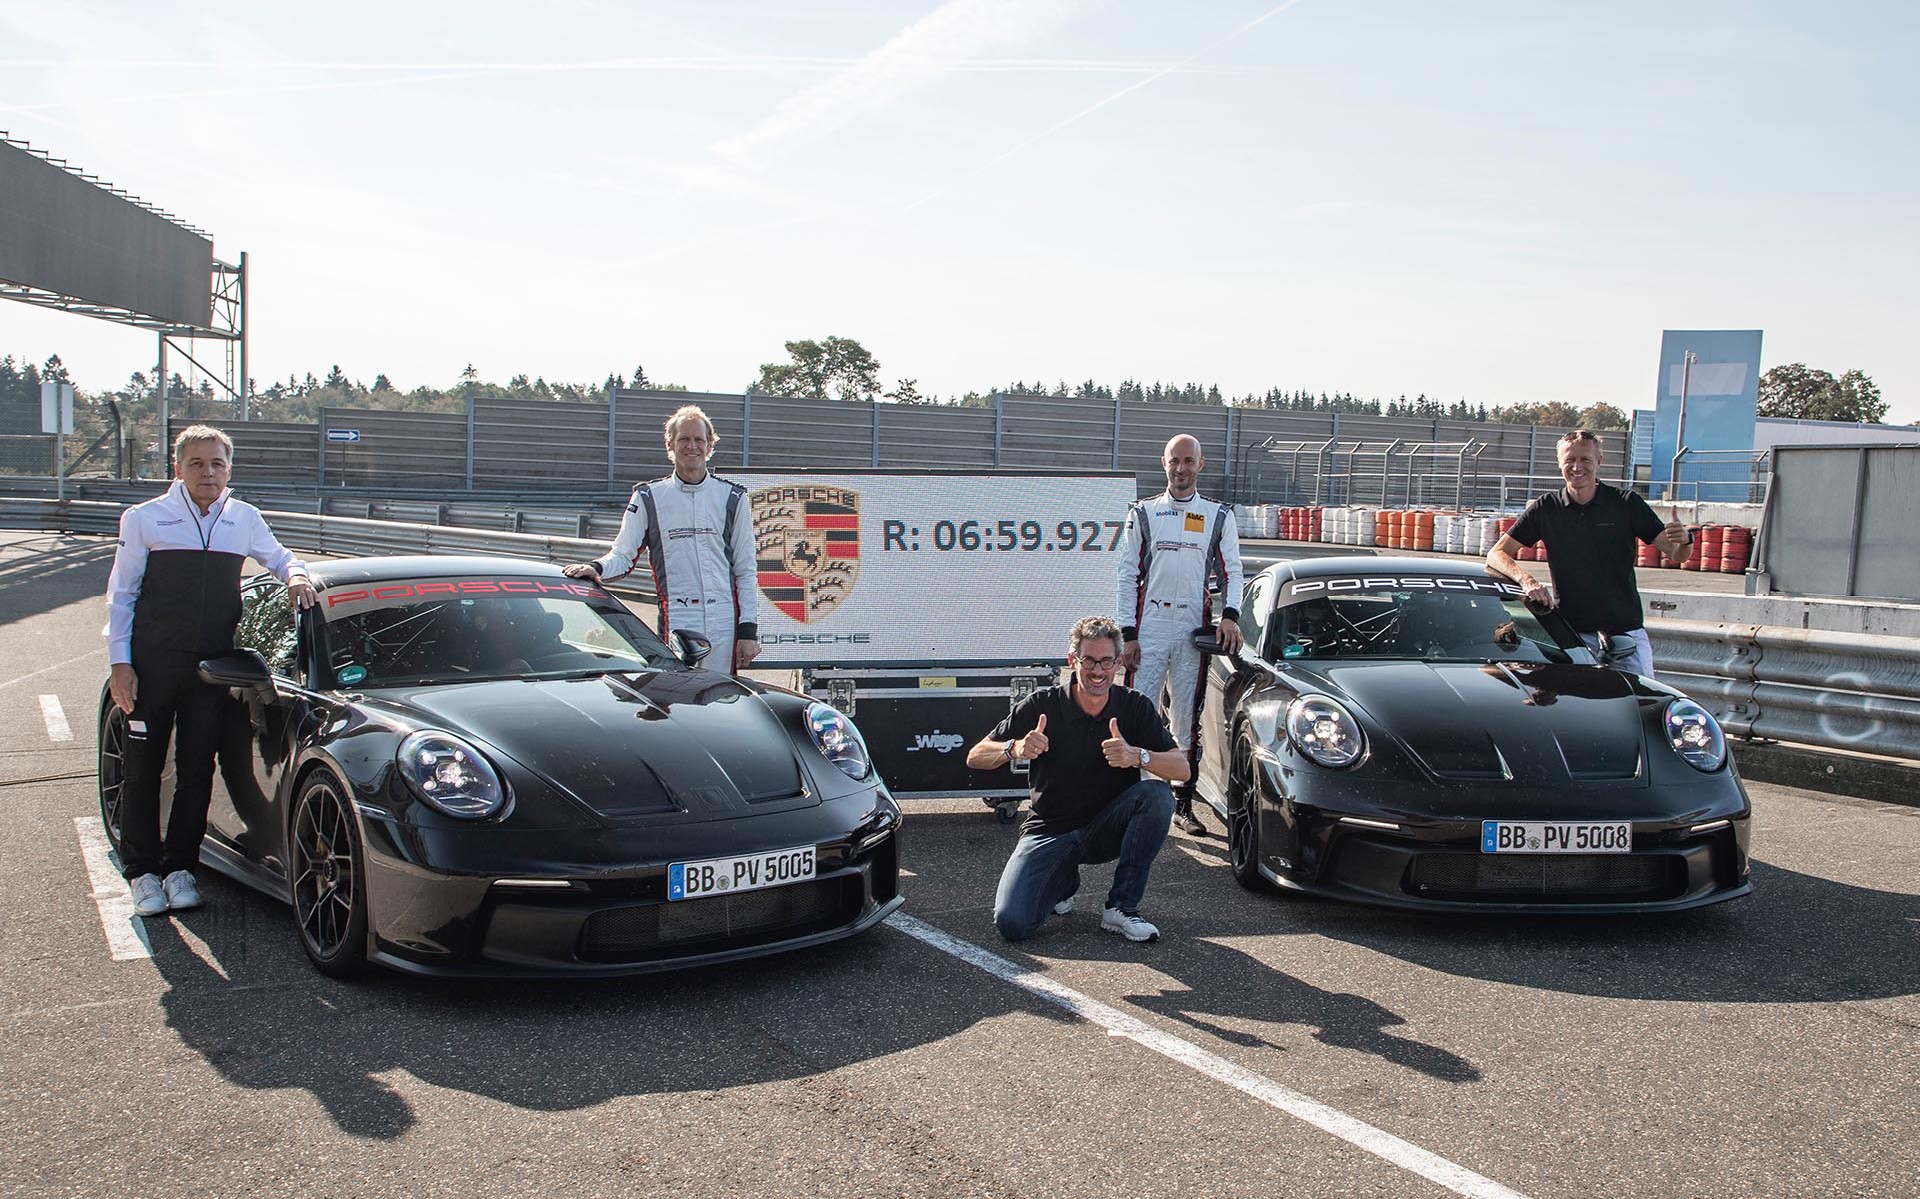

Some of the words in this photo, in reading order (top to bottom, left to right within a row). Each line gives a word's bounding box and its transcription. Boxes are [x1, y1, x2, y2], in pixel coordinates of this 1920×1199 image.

[751, 488, 855, 508] PORSCHE
[883, 519, 919, 551] R:
[933, 520, 1124, 551] 06:59.927
[328, 581, 608, 608] PORSCHE
[1291, 578, 1527, 596] PORSCHE
[761, 632, 870, 644] ORSCHE
[1499, 825, 1526, 849] BB
[1544, 826, 1570, 849] PV
[1576, 826, 1628, 849] 5008
[686, 866, 715, 893] BB
[733, 859, 760, 888] PV
[765, 850, 813, 882] 5005
